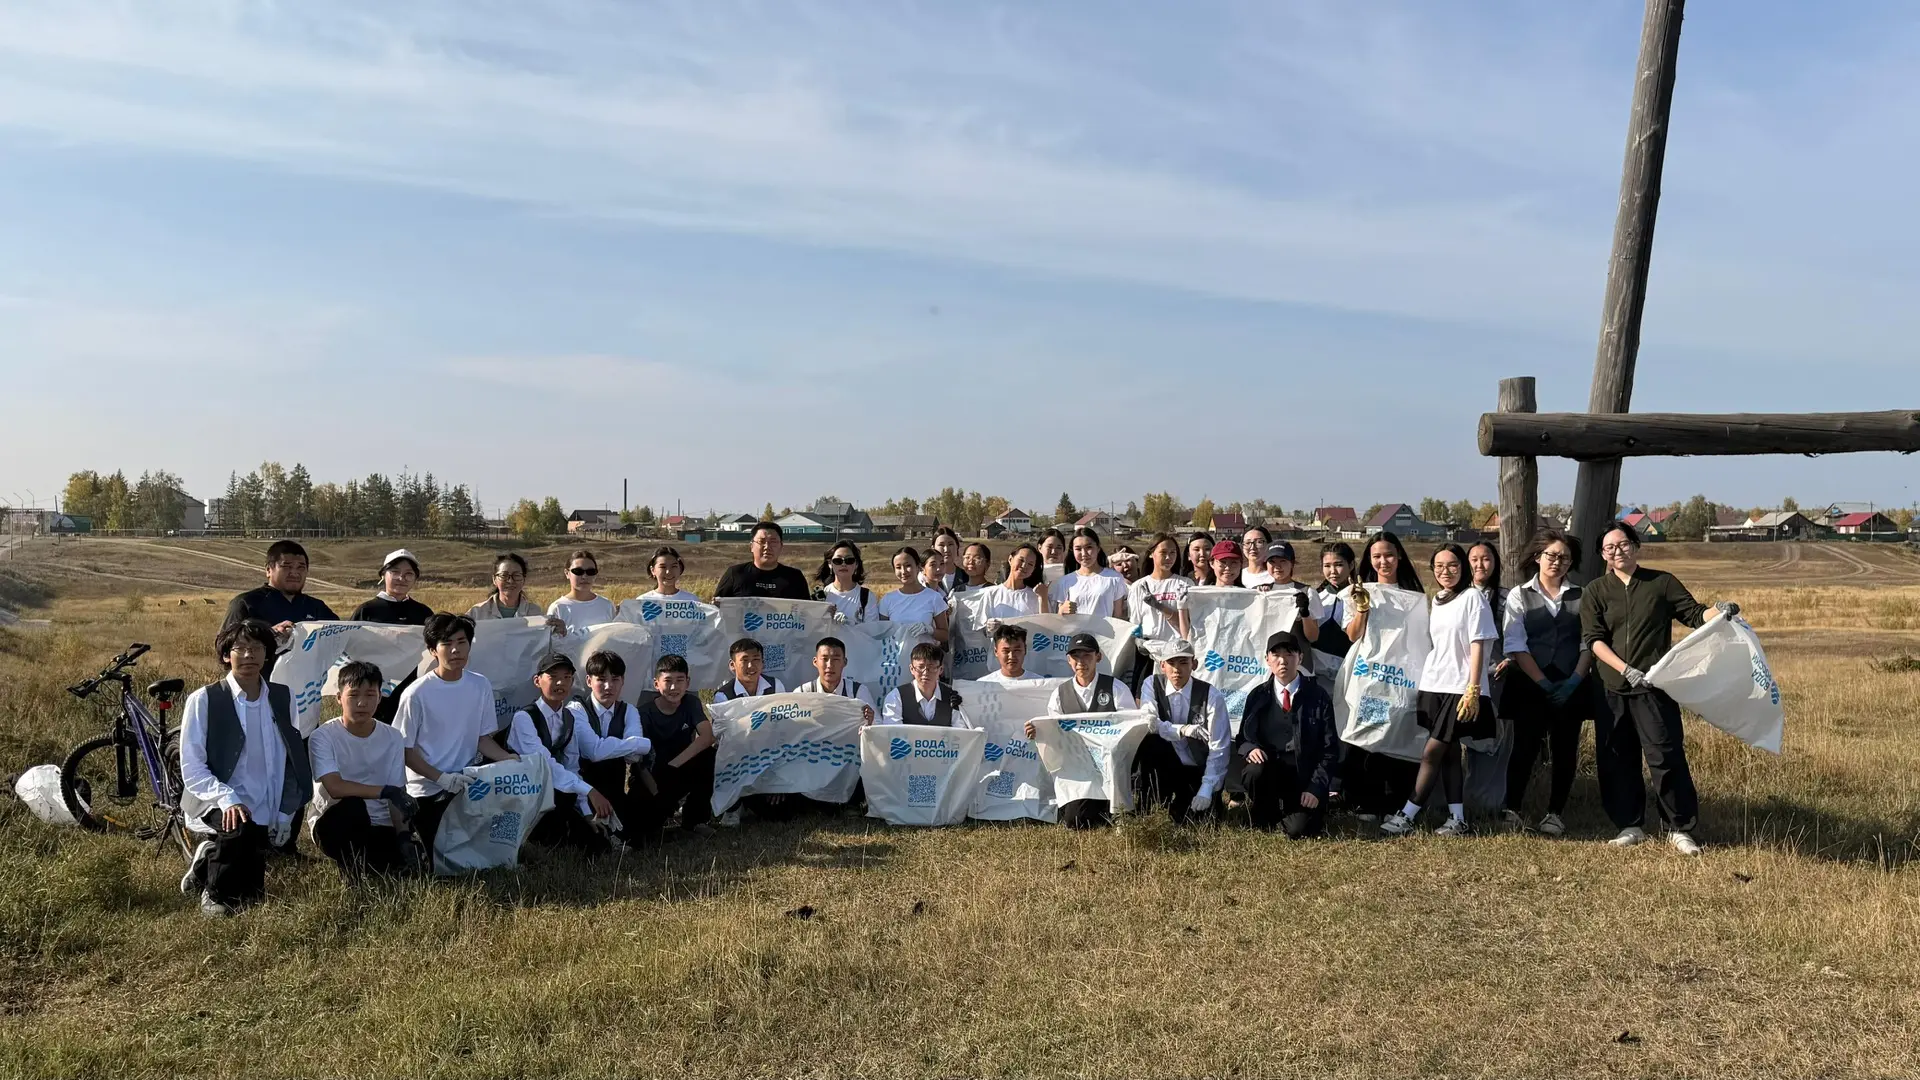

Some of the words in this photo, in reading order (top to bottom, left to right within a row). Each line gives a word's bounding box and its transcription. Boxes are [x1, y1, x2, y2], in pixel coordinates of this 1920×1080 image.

[665, 601, 695, 610] ВОДА
[665, 611, 706, 620] РОССИИ
[766, 613, 794, 622] ВОДА
[766, 621, 805, 631] РОССИИ
[1053, 642, 1069, 652] РОС
[964, 655, 987, 664] РОСС
[1228, 654, 1258, 666] ВОДА
[1227, 664, 1268, 676] РОССИИ
[1372, 662, 1404, 676] ВОДА
[1371, 671, 1416, 689] РОССИИ
[1751, 669, 1770, 691] ВОДА
[495, 697, 507, 708] ДА
[771, 703, 799, 714] ВОДА
[770, 710, 811, 722] РОССИИ
[1081, 719, 1111, 727] ВОДА
[1078, 725, 1122, 735] РОССИИ
[915, 739, 945, 749] ВОДА
[1008, 738, 1029, 750] ОДА
[914, 749, 958, 758] РОССИИ
[1005, 746, 1037, 760] ОССИИ
[494, 773, 529, 786] ВОДА
[494, 783, 542, 796] РОССИИ
